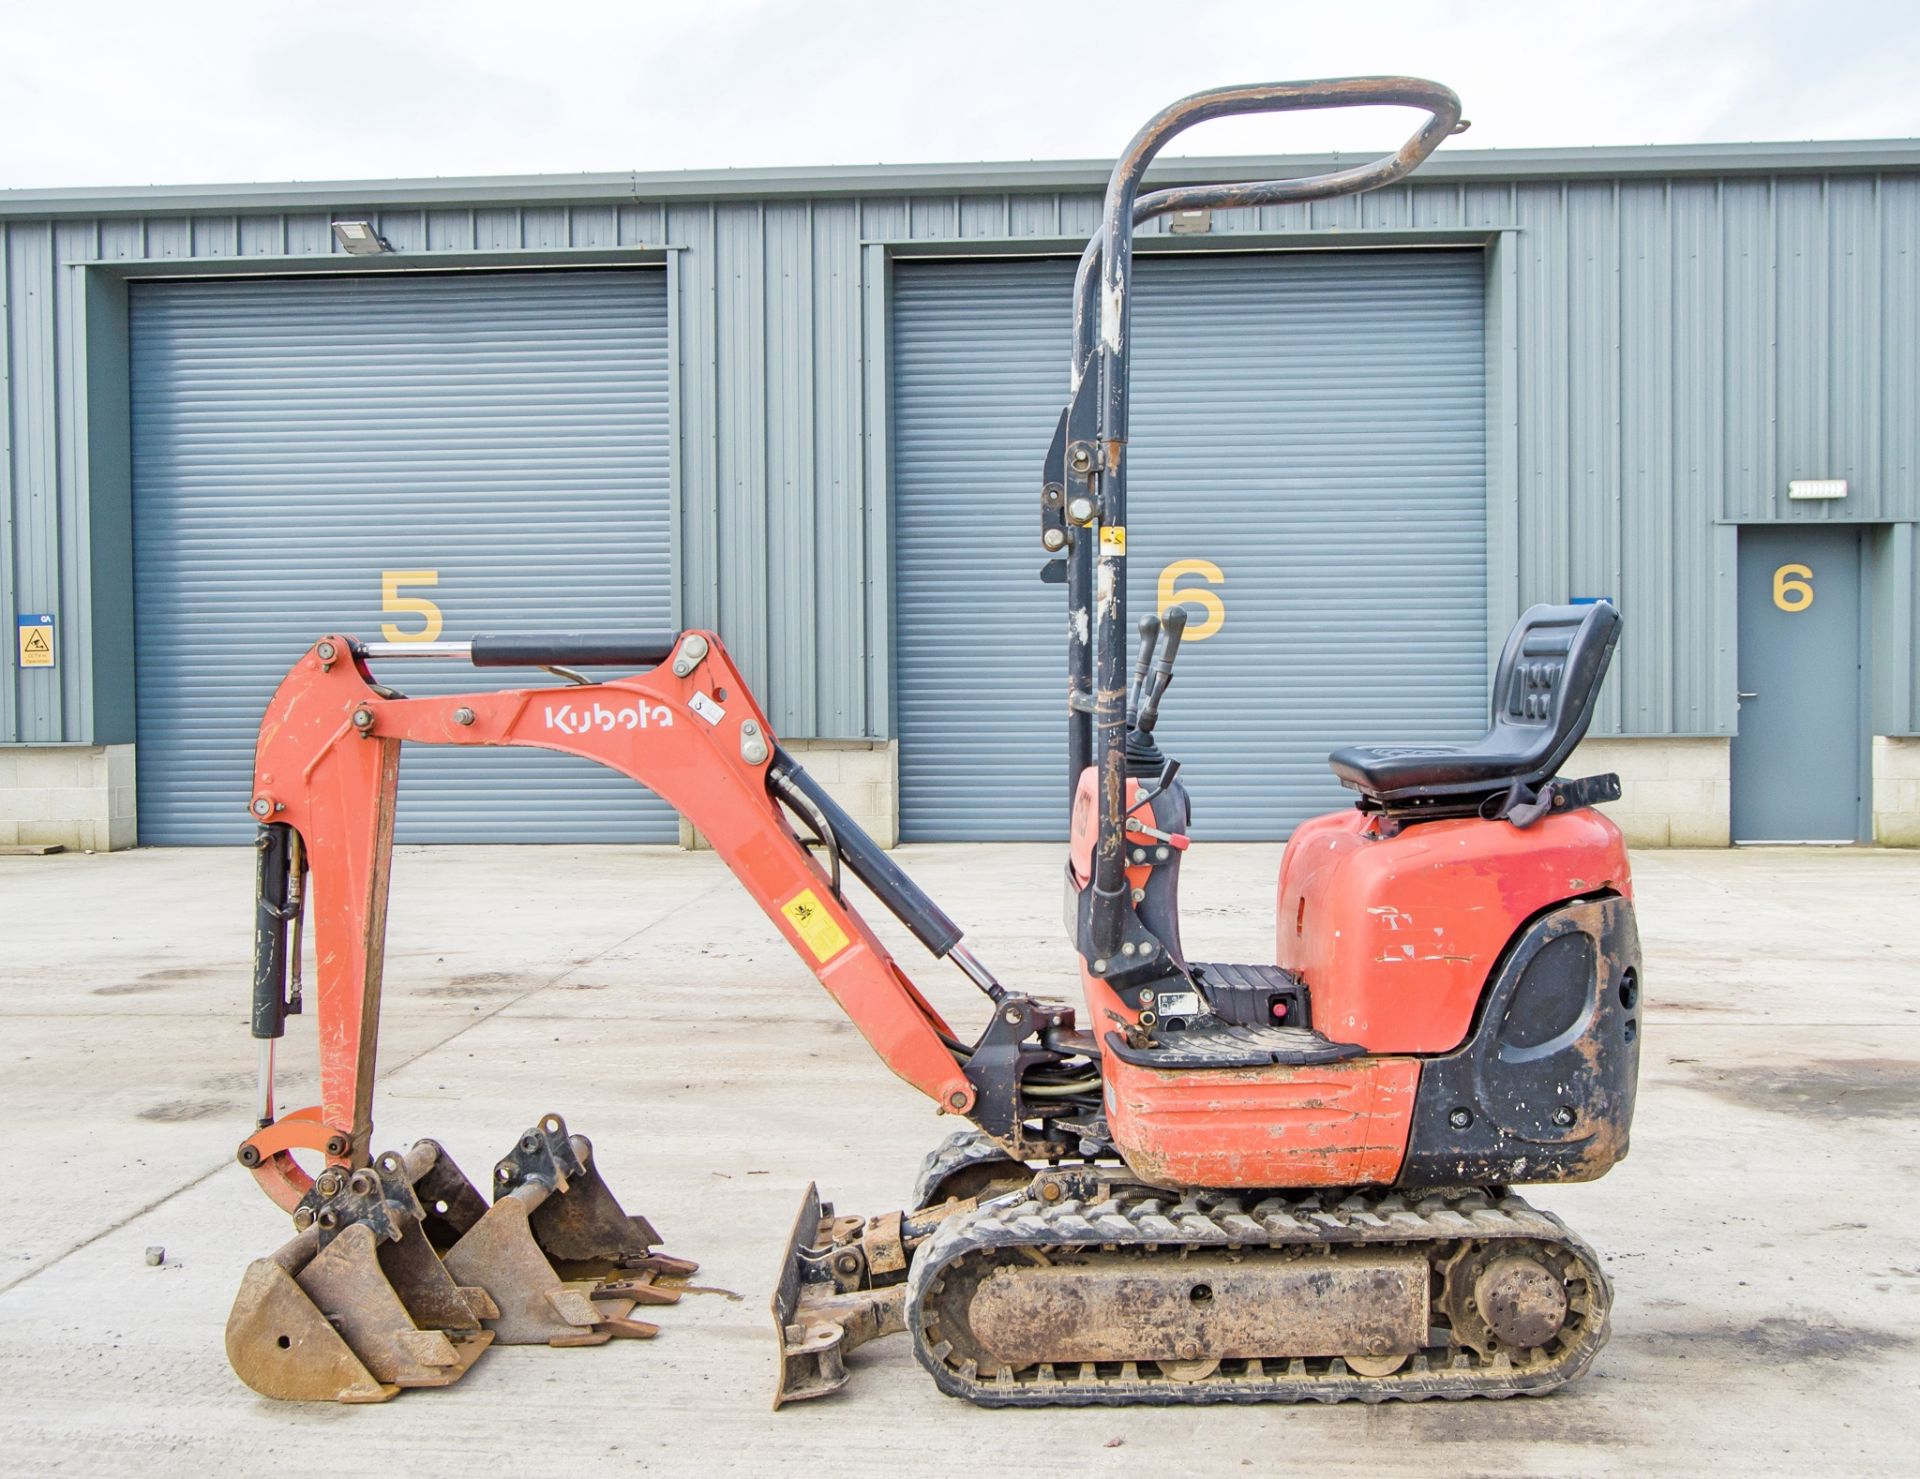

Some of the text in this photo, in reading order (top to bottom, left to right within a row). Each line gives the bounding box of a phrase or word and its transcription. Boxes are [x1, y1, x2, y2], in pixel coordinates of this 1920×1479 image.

[381, 570, 443, 643] 5
[1157, 559, 1226, 642] 6
[1772, 563, 1814, 612] 6
[544, 699, 673, 734] Kubota
